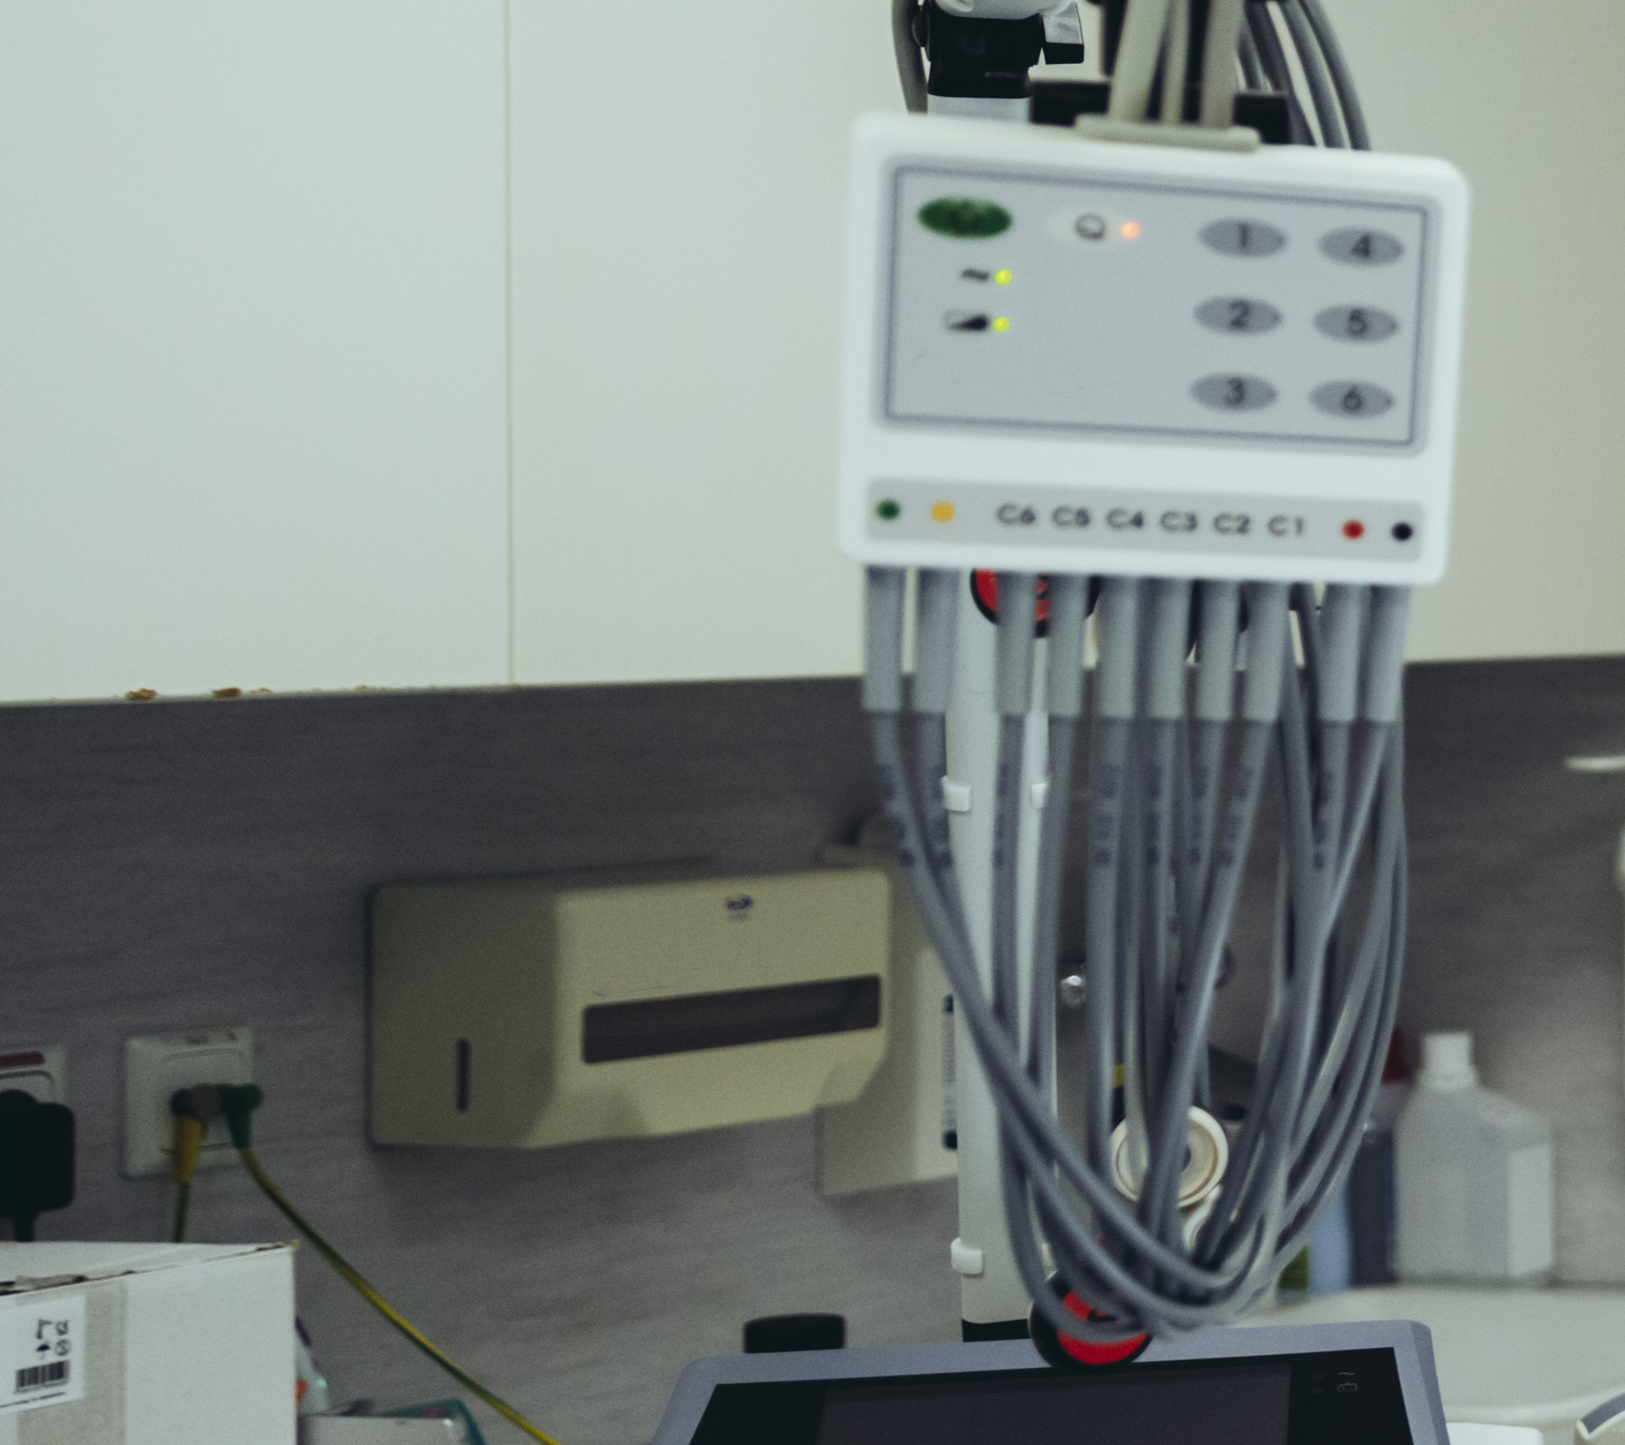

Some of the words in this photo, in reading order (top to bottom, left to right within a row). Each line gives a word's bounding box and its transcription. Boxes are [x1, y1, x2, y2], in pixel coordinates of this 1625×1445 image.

[1237, 223, 1248, 249] 1
[1349, 233, 1371, 258] 4
[1229, 303, 1250, 330] 2
[1346, 310, 1368, 337] 5
[1226, 377, 1246, 405] 3
[1342, 385, 1363, 412] 6
[996, 503, 1036, 526] C6
[1106, 507, 1145, 530] C4
[1160, 509, 1198, 533] C3
[1213, 512, 1251, 535] C2
[1267, 514, 1304, 537] C1
